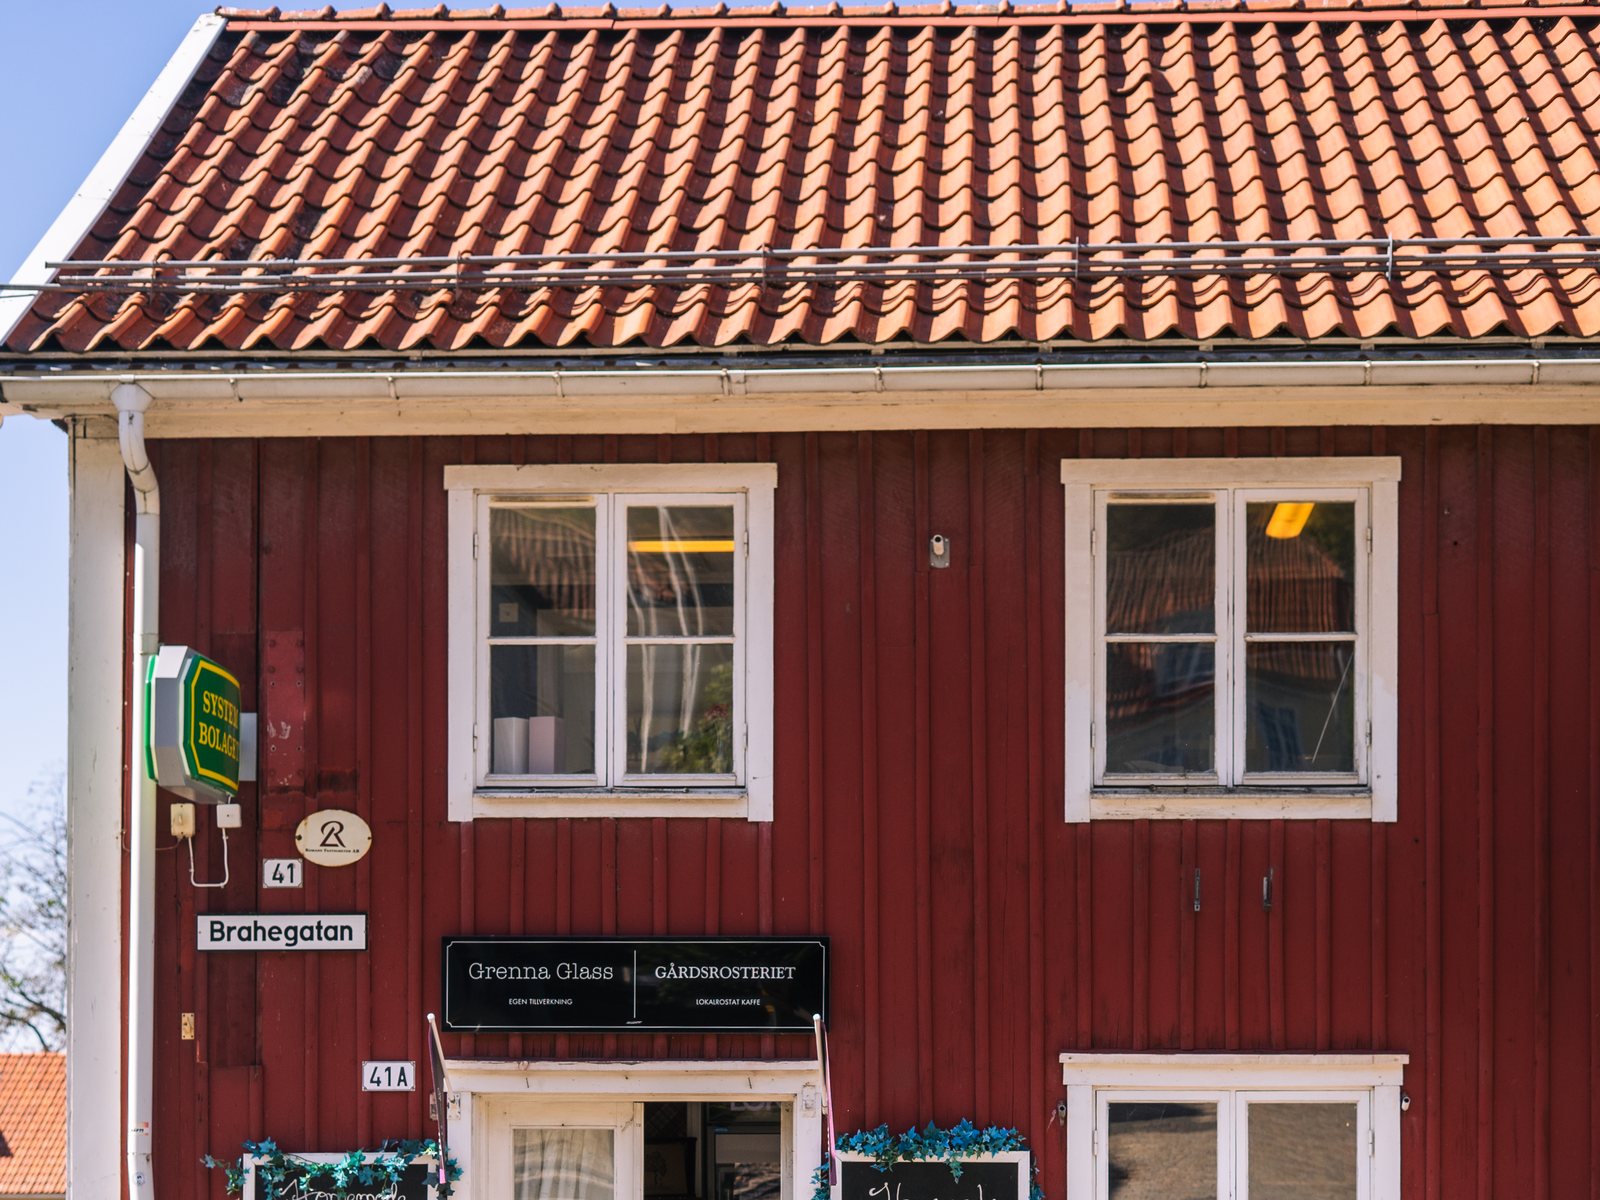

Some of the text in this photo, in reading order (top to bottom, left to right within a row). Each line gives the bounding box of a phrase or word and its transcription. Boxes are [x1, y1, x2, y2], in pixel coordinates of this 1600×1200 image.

[203, 690, 239, 729] SYSTEM
[272, 863, 295, 884] 41
[209, 920, 353, 947] Brahegatan
[468, 962, 613, 980] Grenna Glass
[655, 962, 796, 979] GÅRDSROSTERIET
[696, 998, 760, 1006] LOKALROSTAT KAFFE
[369, 1065, 408, 1088] 41A
